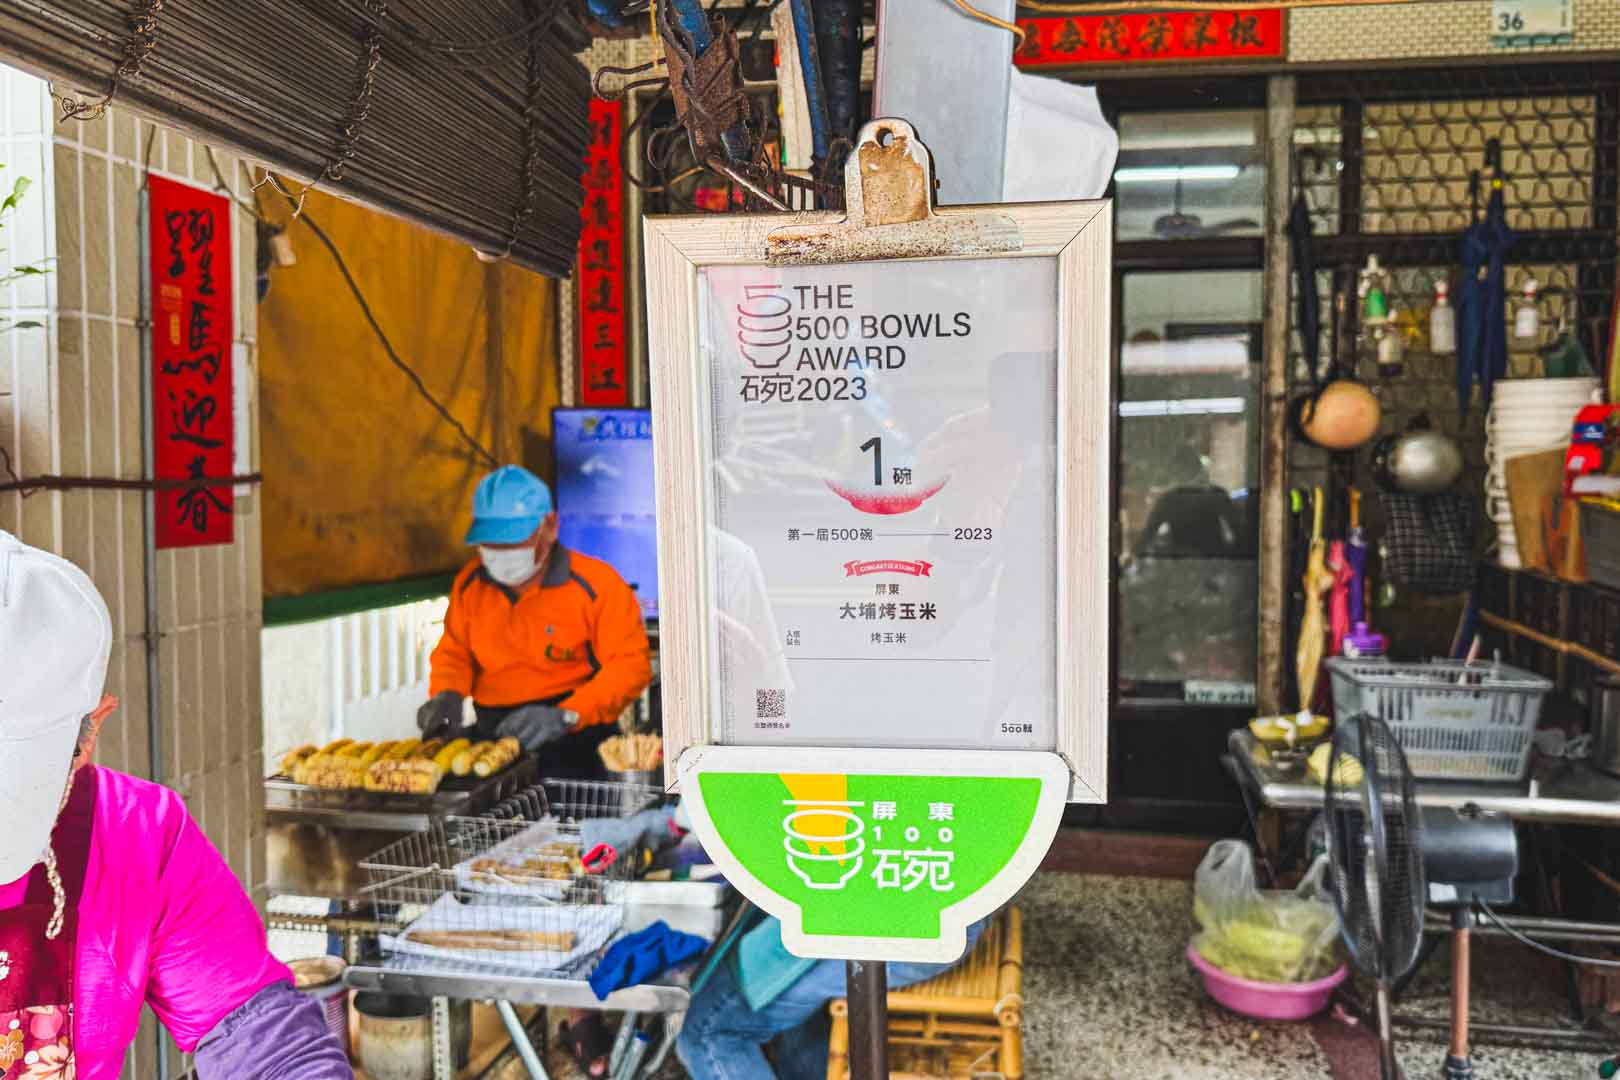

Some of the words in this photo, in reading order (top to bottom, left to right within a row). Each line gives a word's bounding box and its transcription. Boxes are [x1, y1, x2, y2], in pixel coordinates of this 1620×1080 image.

[1498, 12, 1524, 31] 36
[793, 284, 853, 310] THE
[796, 314, 850, 341] 500
[860, 312, 971, 339] BOWLS
[796, 345, 906, 371] AWARD
[893, 467, 912, 486] 碗
[954, 527, 993, 541] 2023
[840, 602, 937, 621] 大埔烤玉米
[871, 632, 907, 644] 烤玉米
[872, 801, 955, 822] 屏東
